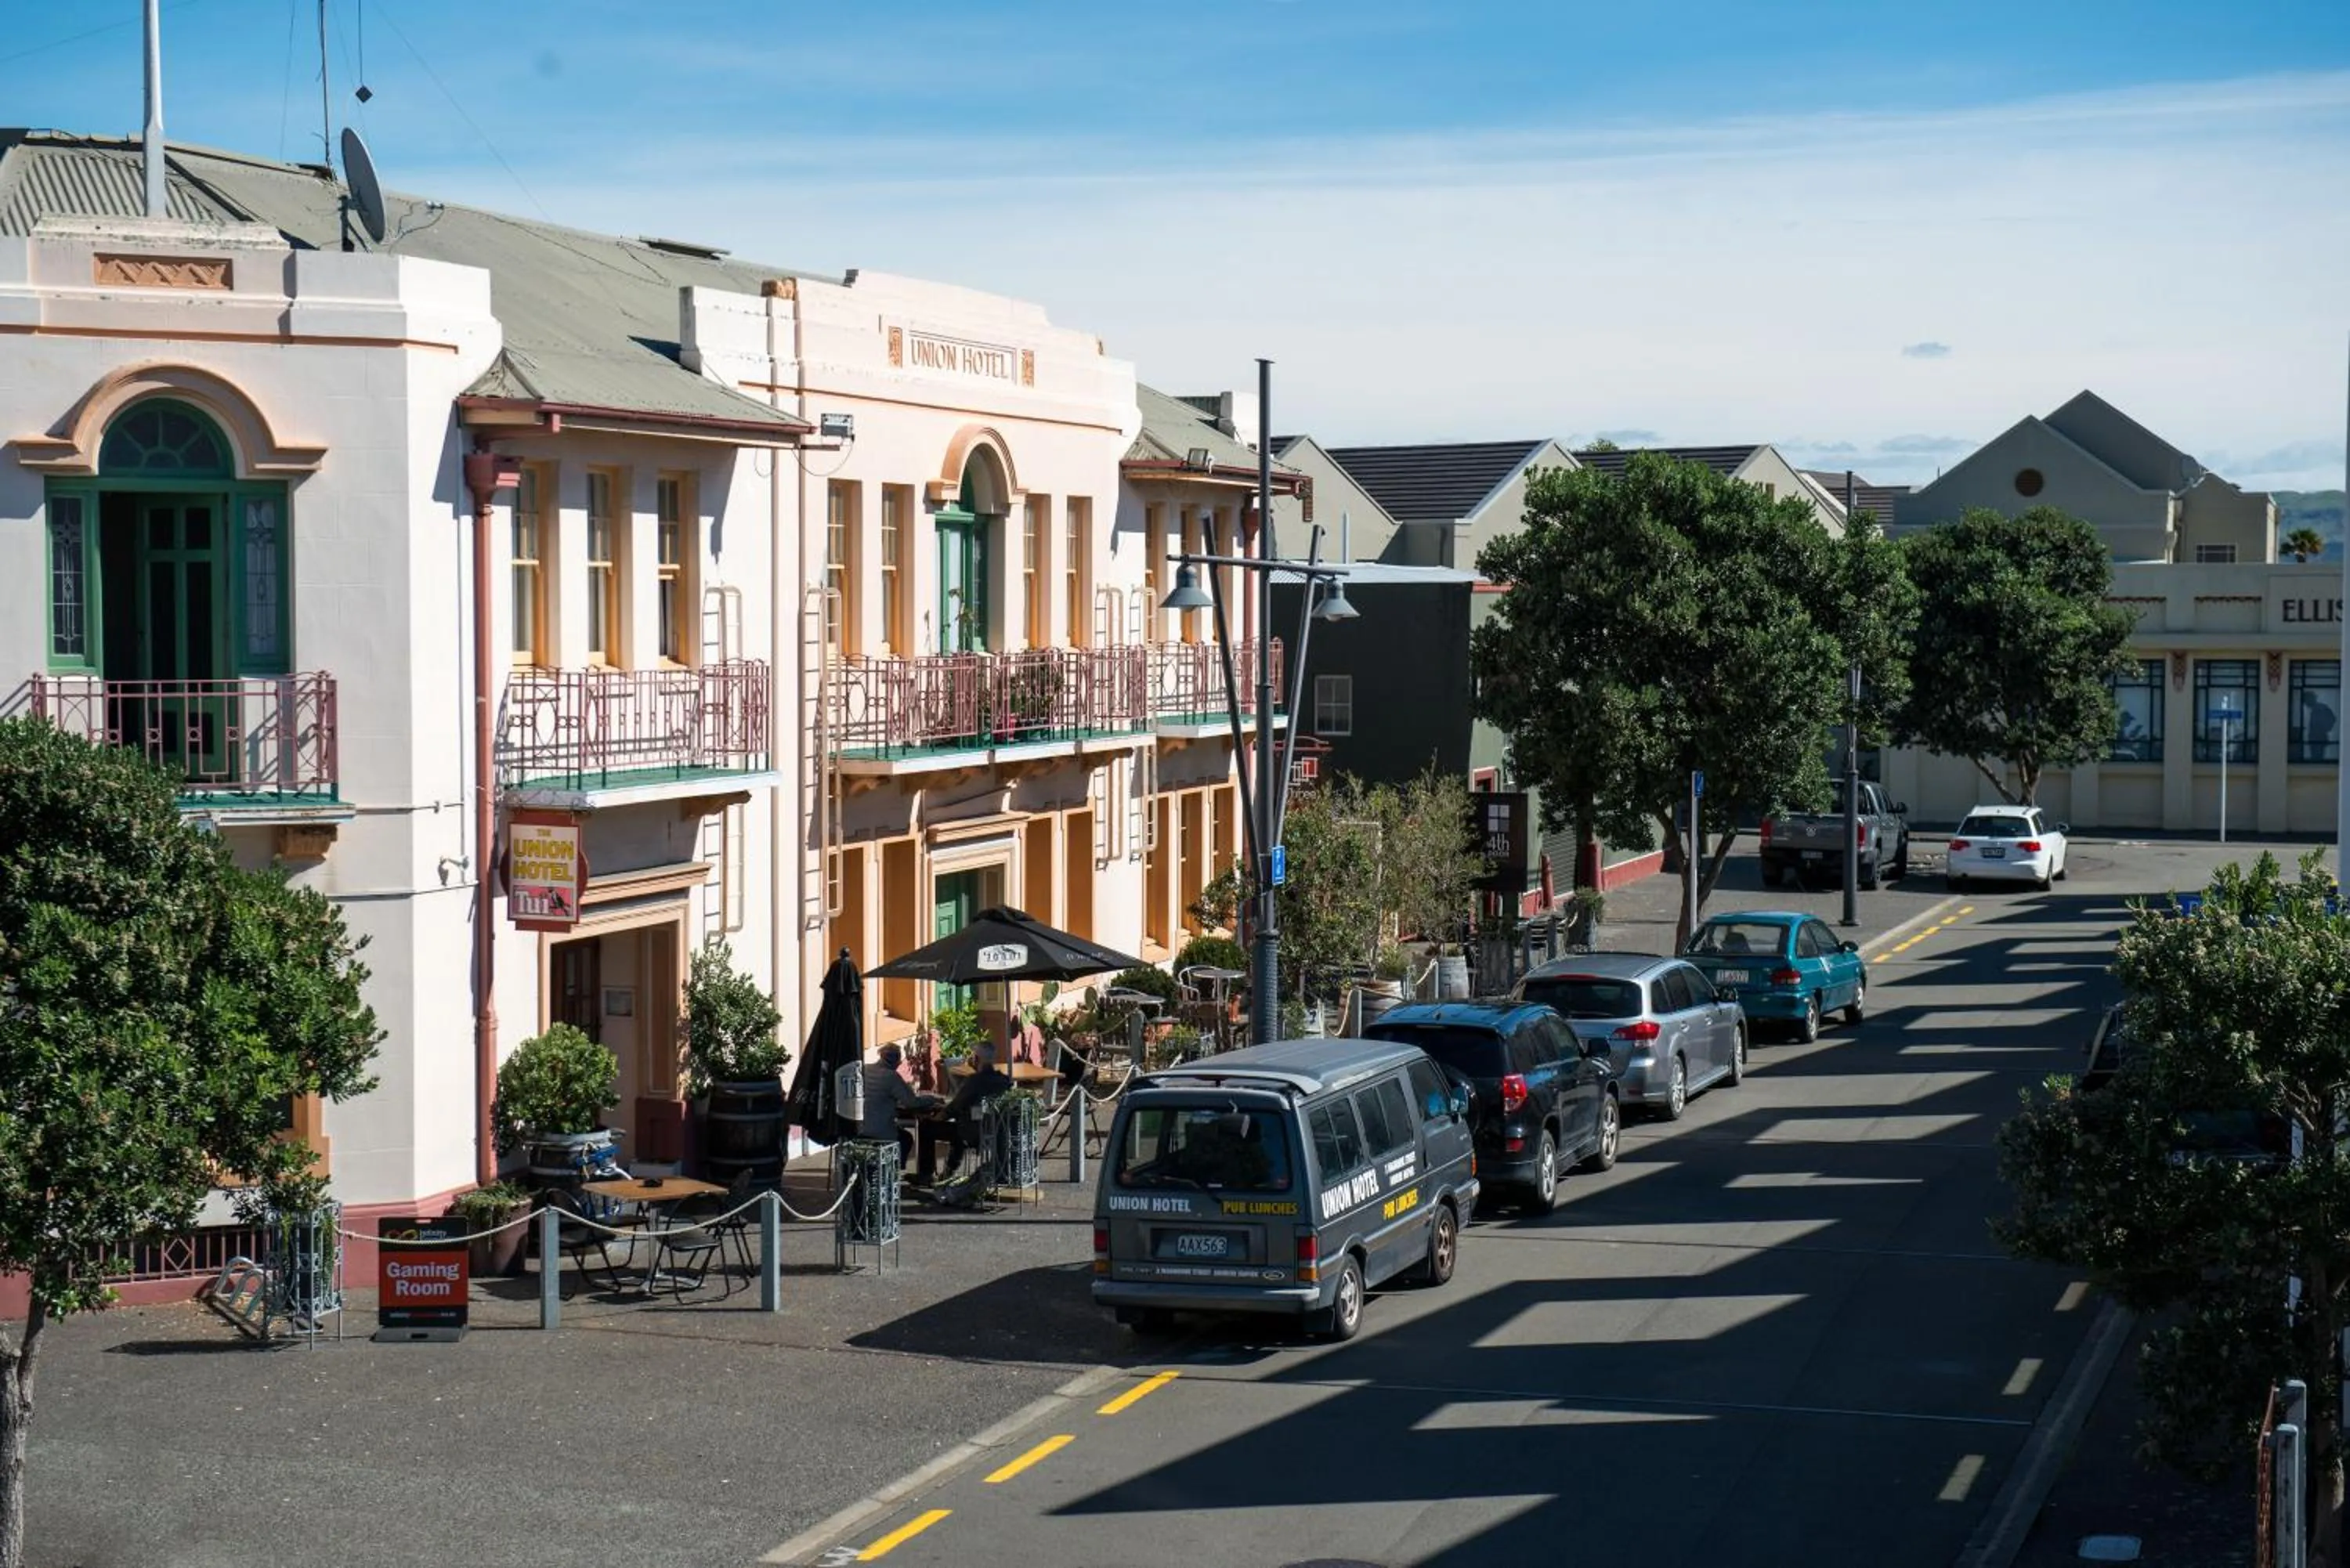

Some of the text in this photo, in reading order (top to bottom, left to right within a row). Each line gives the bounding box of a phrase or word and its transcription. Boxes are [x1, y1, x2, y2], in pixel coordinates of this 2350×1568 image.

[910, 338, 1009, 378] UNION HOTEL
[513, 839, 573, 860] UNION
[513, 859, 573, 881] HOTEL
[1109, 1196, 1191, 1212] UNION HOTEL
[1321, 1181, 1352, 1219] UNION
[1351, 1169, 1379, 1203] HOTEL
[1223, 1201, 1298, 1215] PUB LUNCHES
[386, 1262, 461, 1281] Gaming
[396, 1280, 451, 1296] Room
